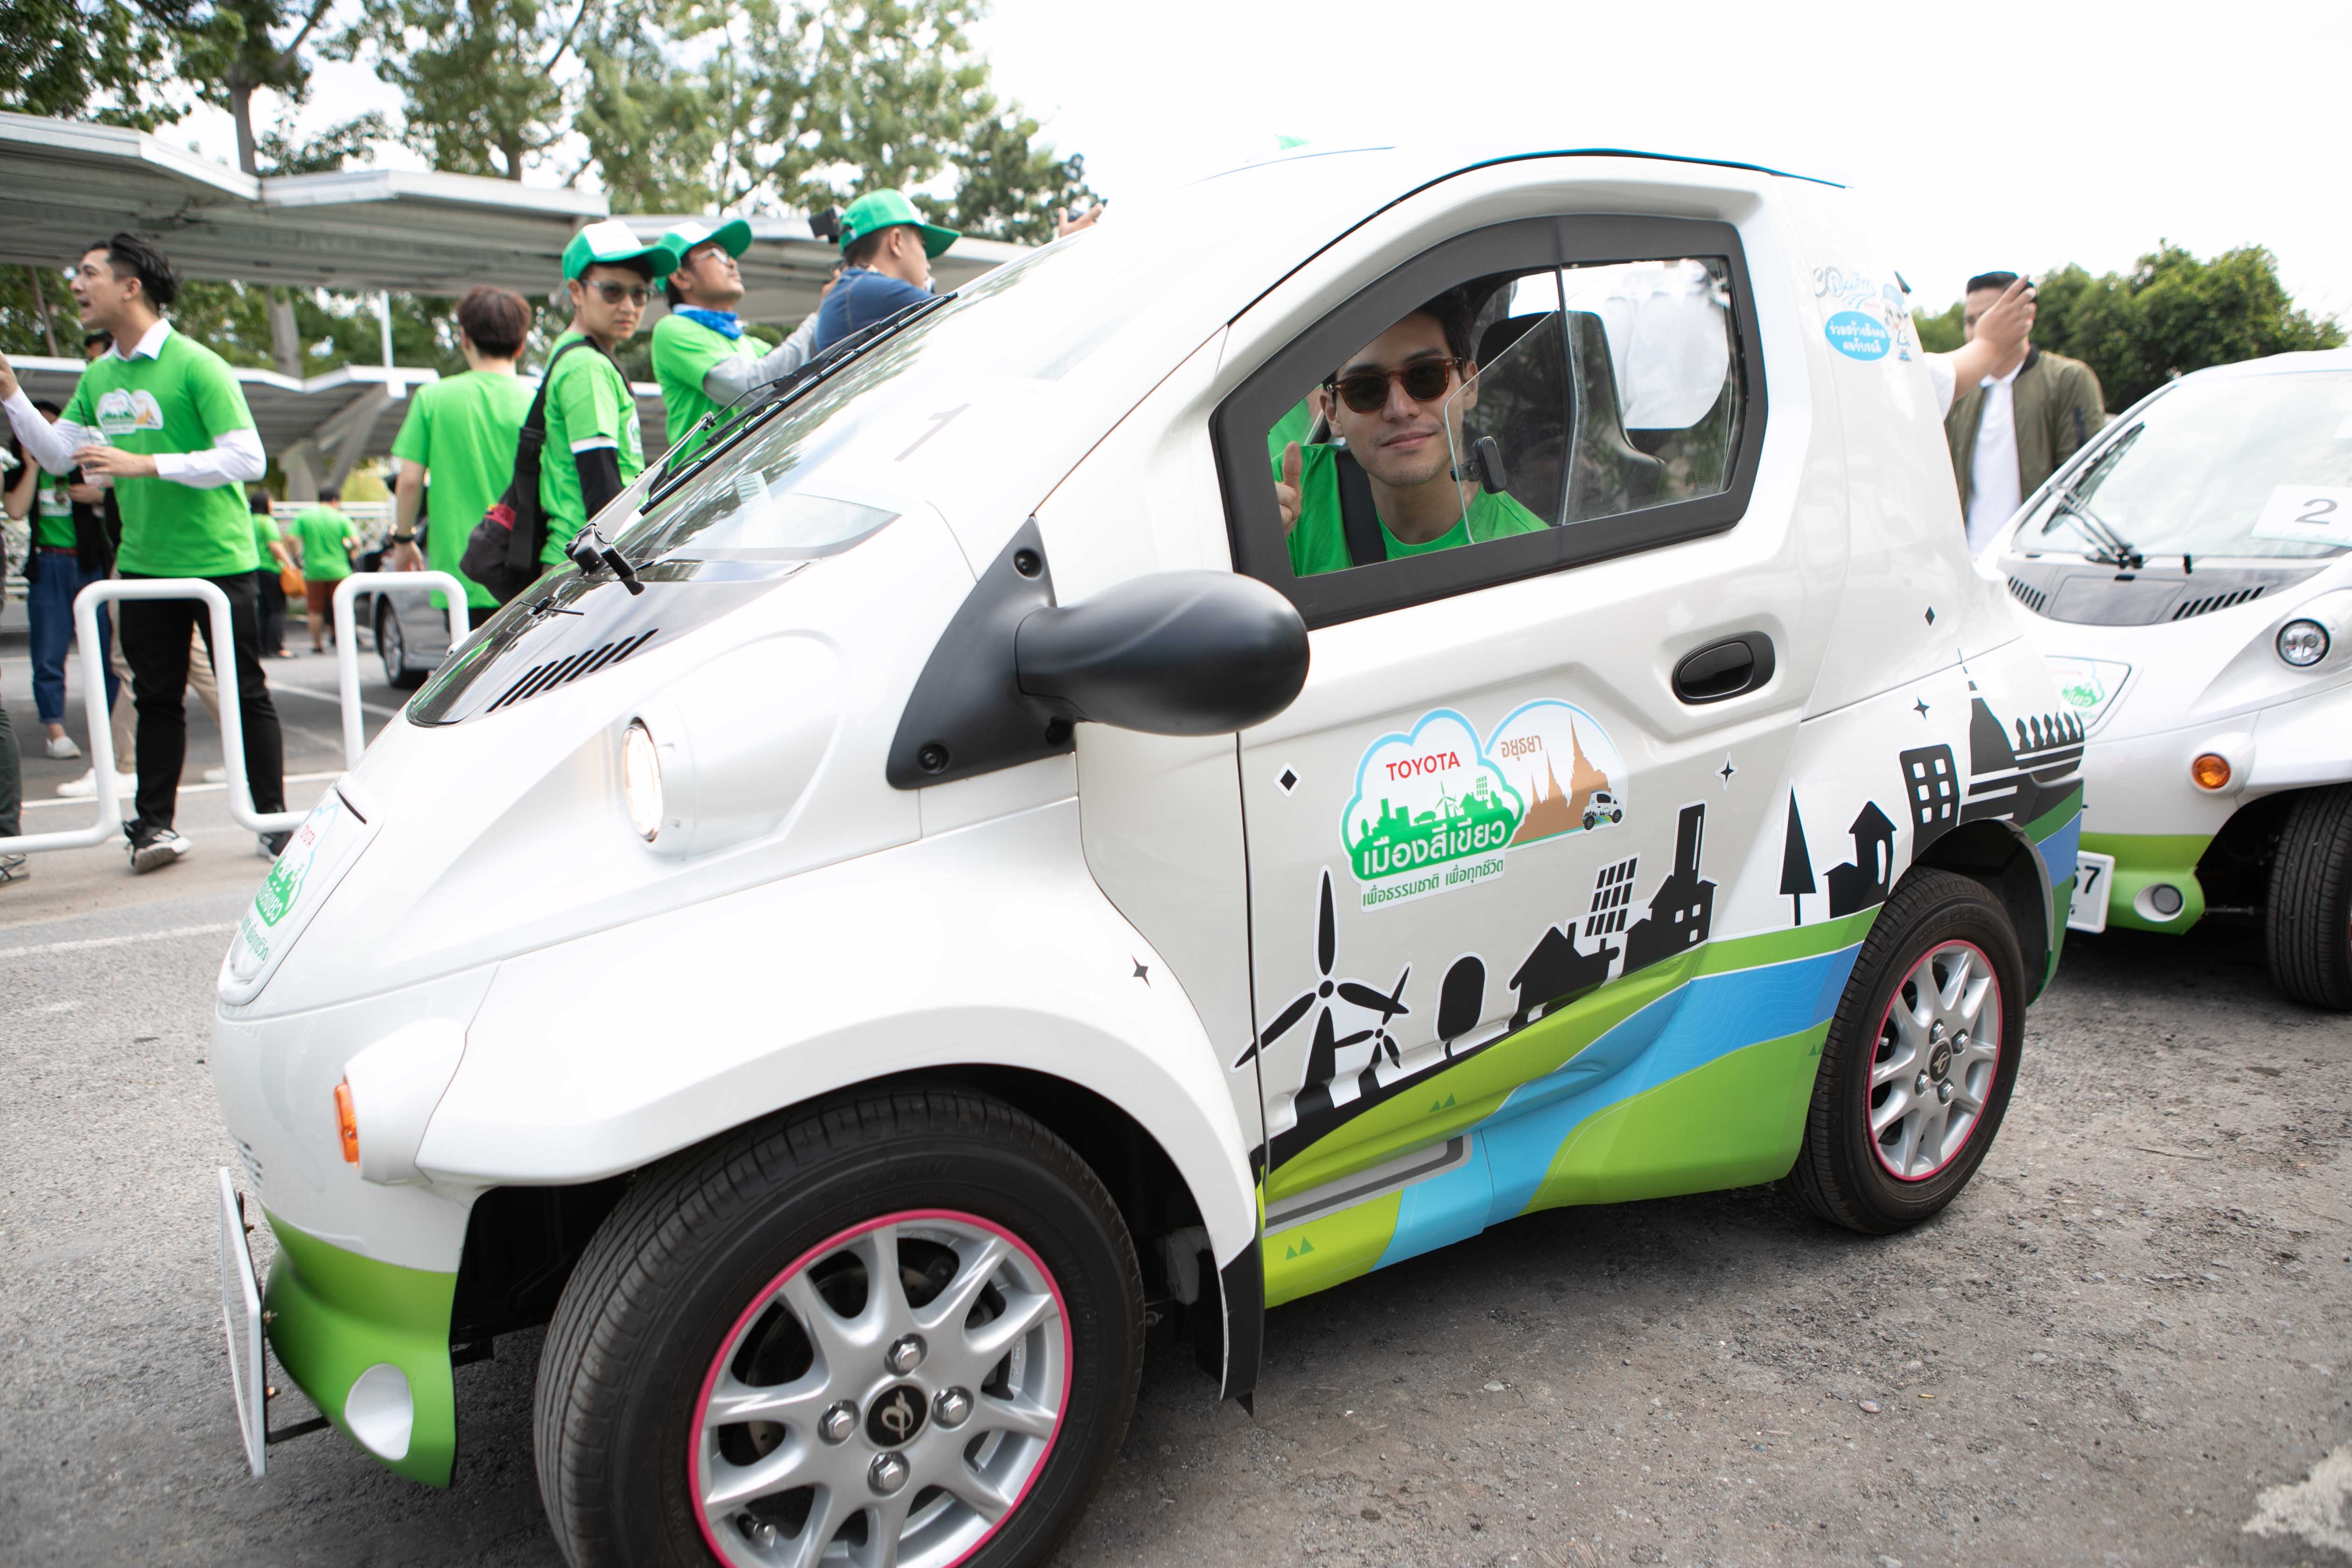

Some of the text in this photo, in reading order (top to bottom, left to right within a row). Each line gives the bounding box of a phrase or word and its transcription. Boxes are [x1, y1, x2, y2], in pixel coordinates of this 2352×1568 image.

[2294, 498, 2338, 525] 2
[1500, 735, 1542, 762] อยุธยา
[1386, 751, 1461, 781] TOYOTA
[1363, 819, 1506, 875] เมืองสีเขียว
[1362, 858, 1504, 907] เพื่อธรรมชาติ เพื่อทุกชีวิต
